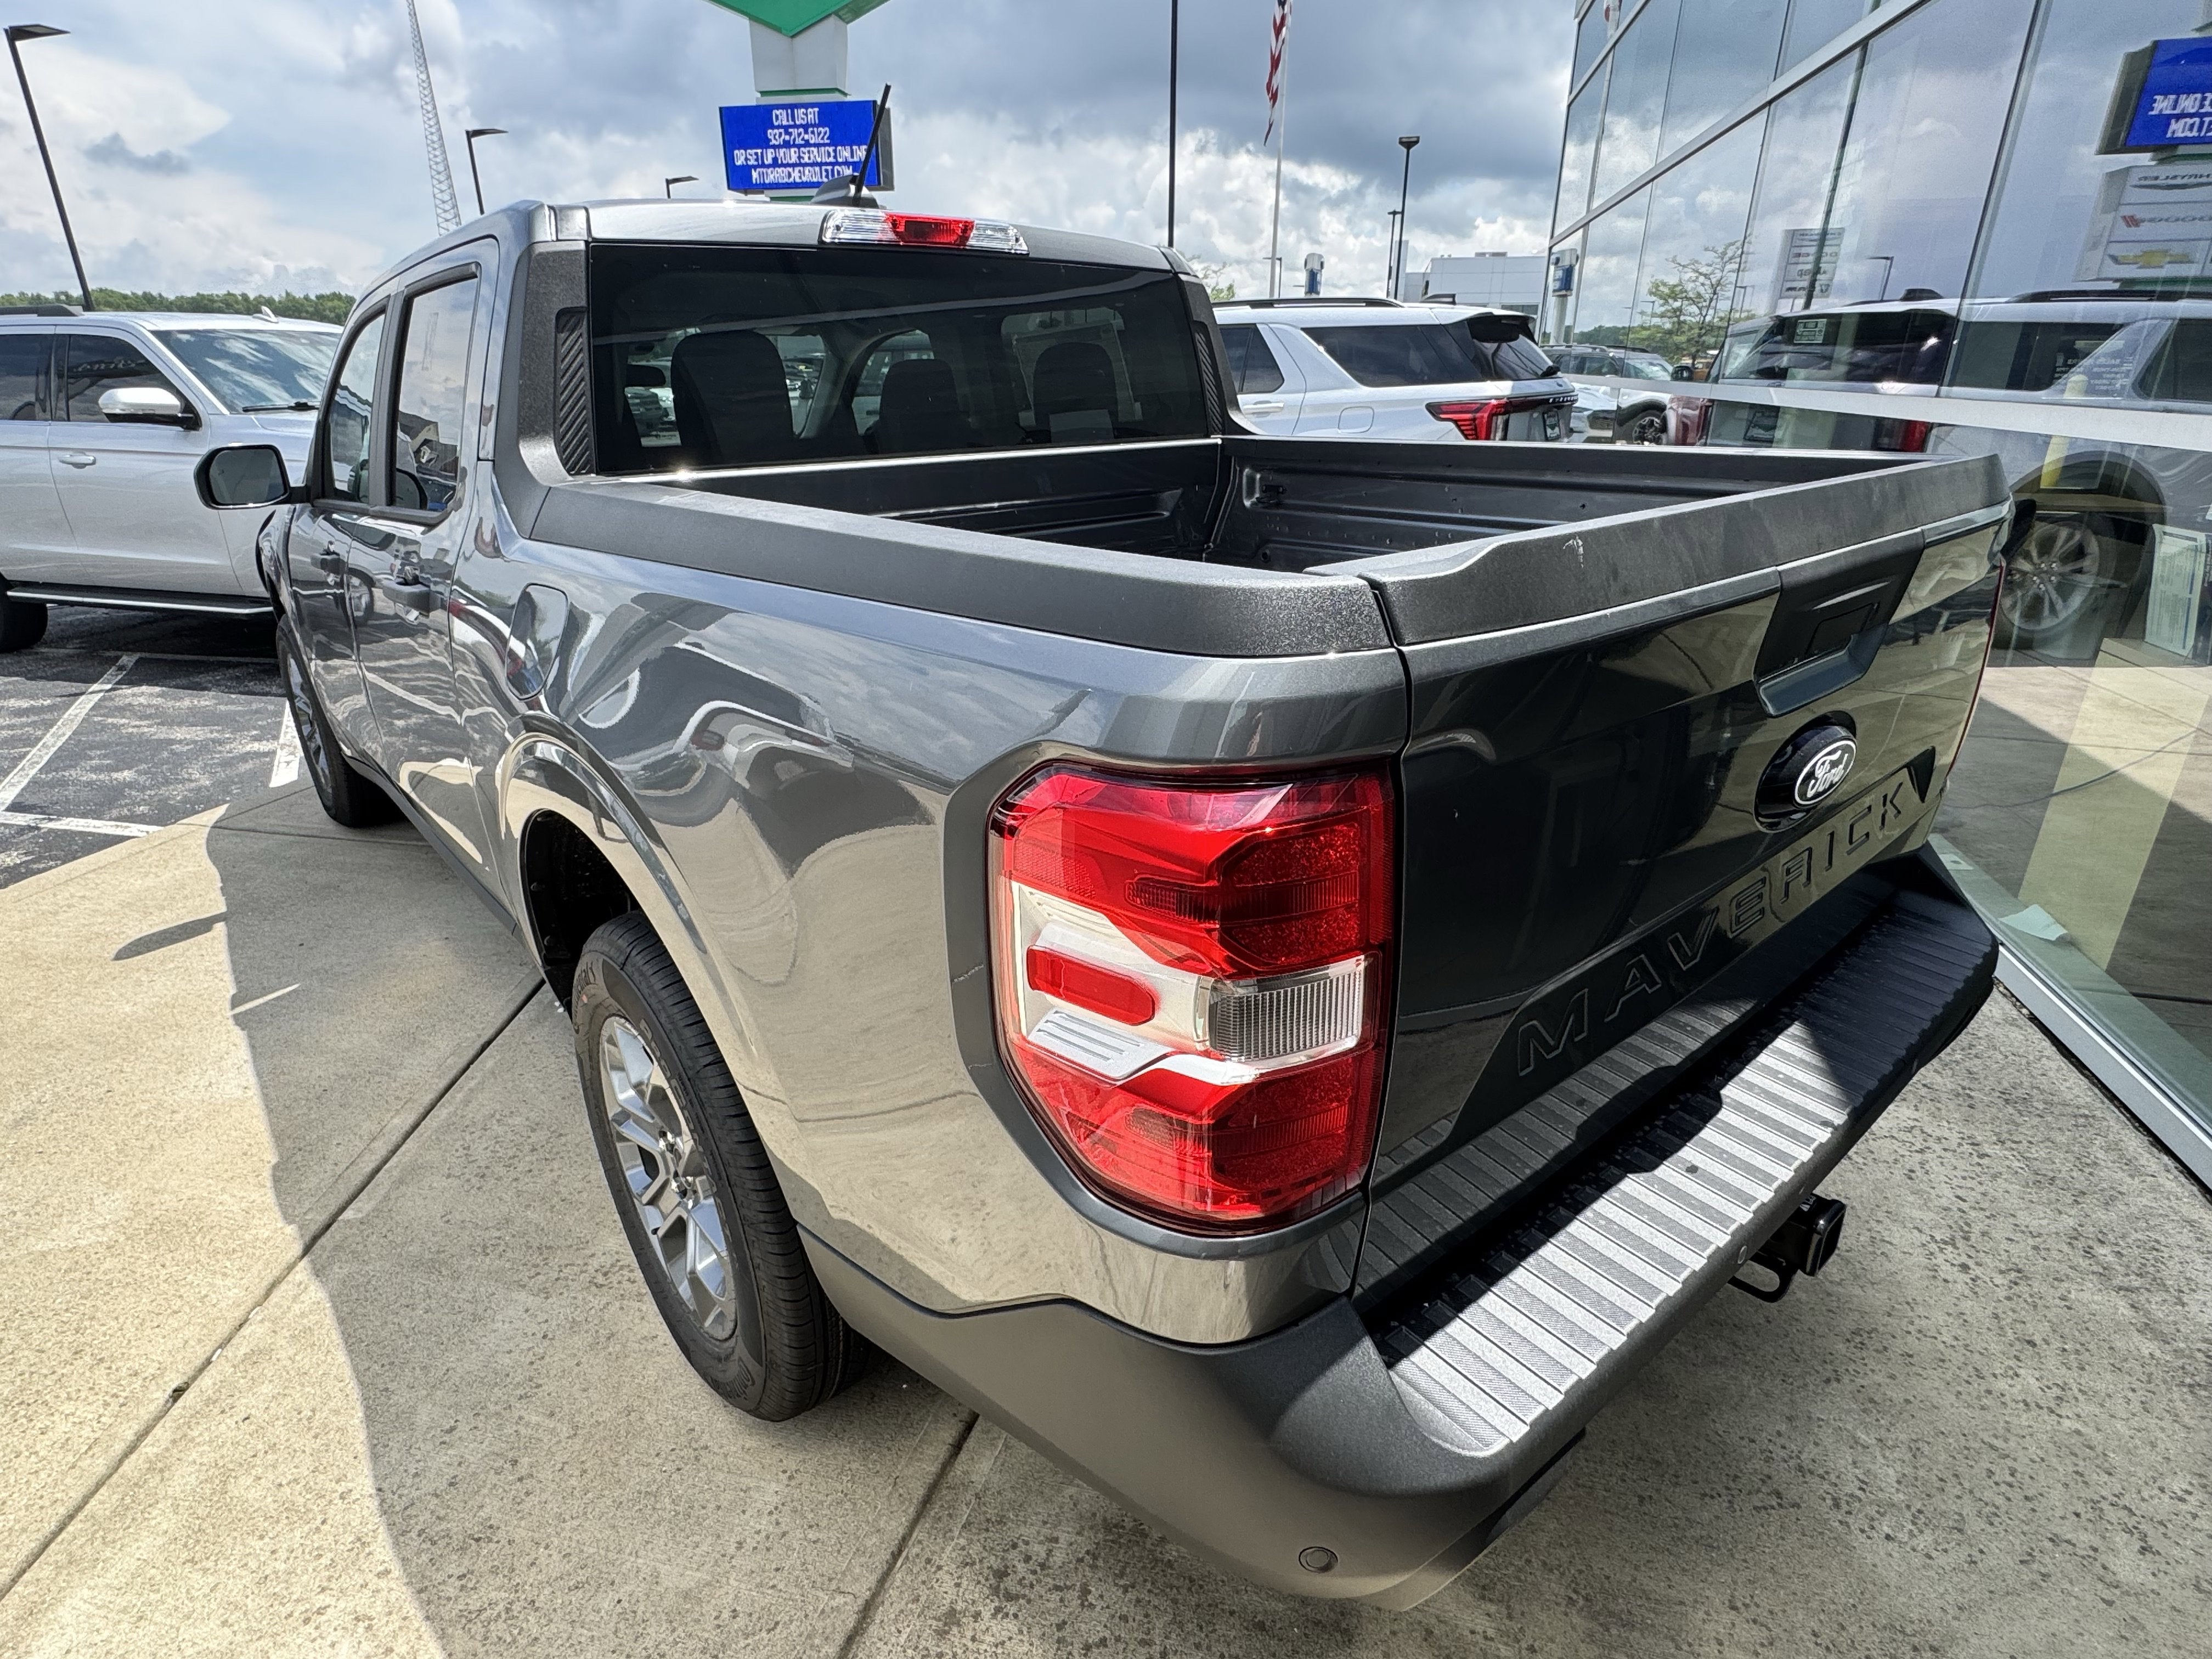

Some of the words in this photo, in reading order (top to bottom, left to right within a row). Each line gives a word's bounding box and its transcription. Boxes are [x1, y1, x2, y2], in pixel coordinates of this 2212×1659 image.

[772, 108, 794, 126] CALL
[794, 108, 807, 125] US
[808, 108, 819, 124] AT
[768, 127, 830, 145] 937-712-6122
[733, 149, 746, 166] OR
[747, 149, 762, 165] SET
[763, 148, 775, 165] UP
[776, 147, 799, 164] YOUR
[800, 146, 836, 163] SERVICE
[1807, 750, 1848, 798] Ford
[1517, 781, 1904, 1076] MAVERICK
